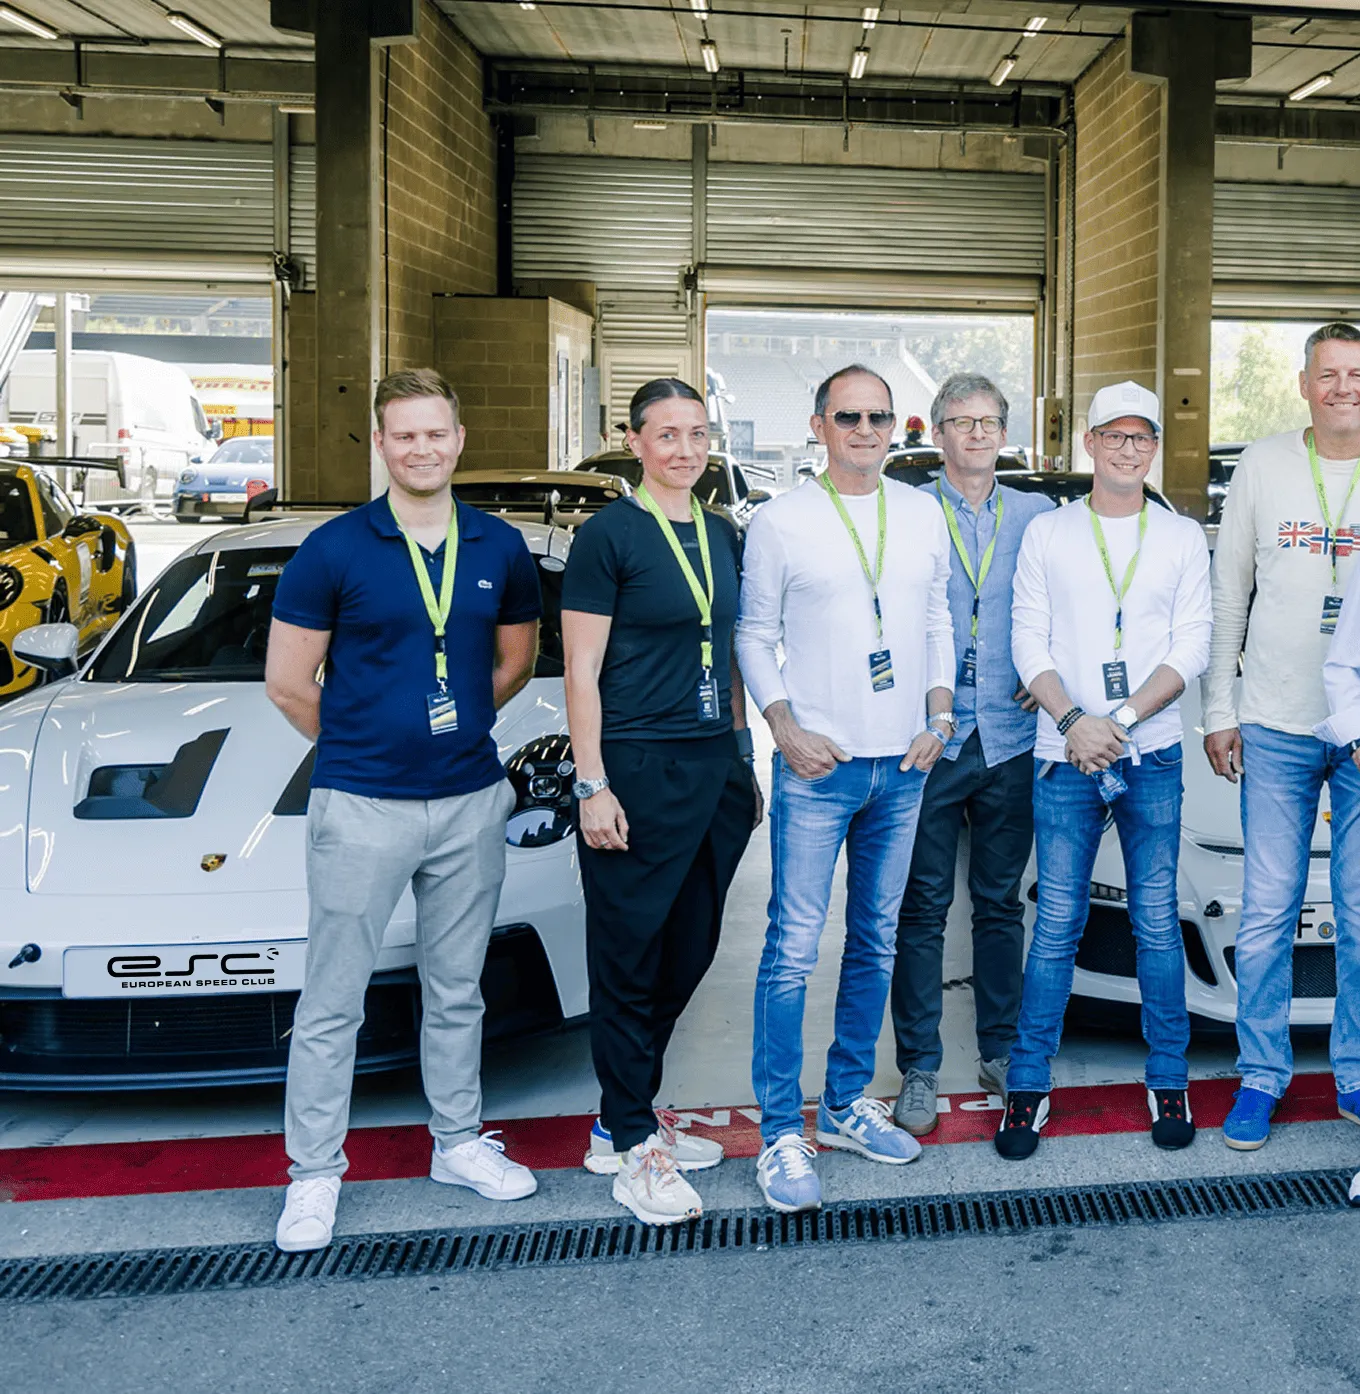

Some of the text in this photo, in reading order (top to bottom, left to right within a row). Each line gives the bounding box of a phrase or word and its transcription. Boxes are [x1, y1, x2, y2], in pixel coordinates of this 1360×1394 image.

[121, 978, 276, 989] EUROPEAN SPEED CLUB
